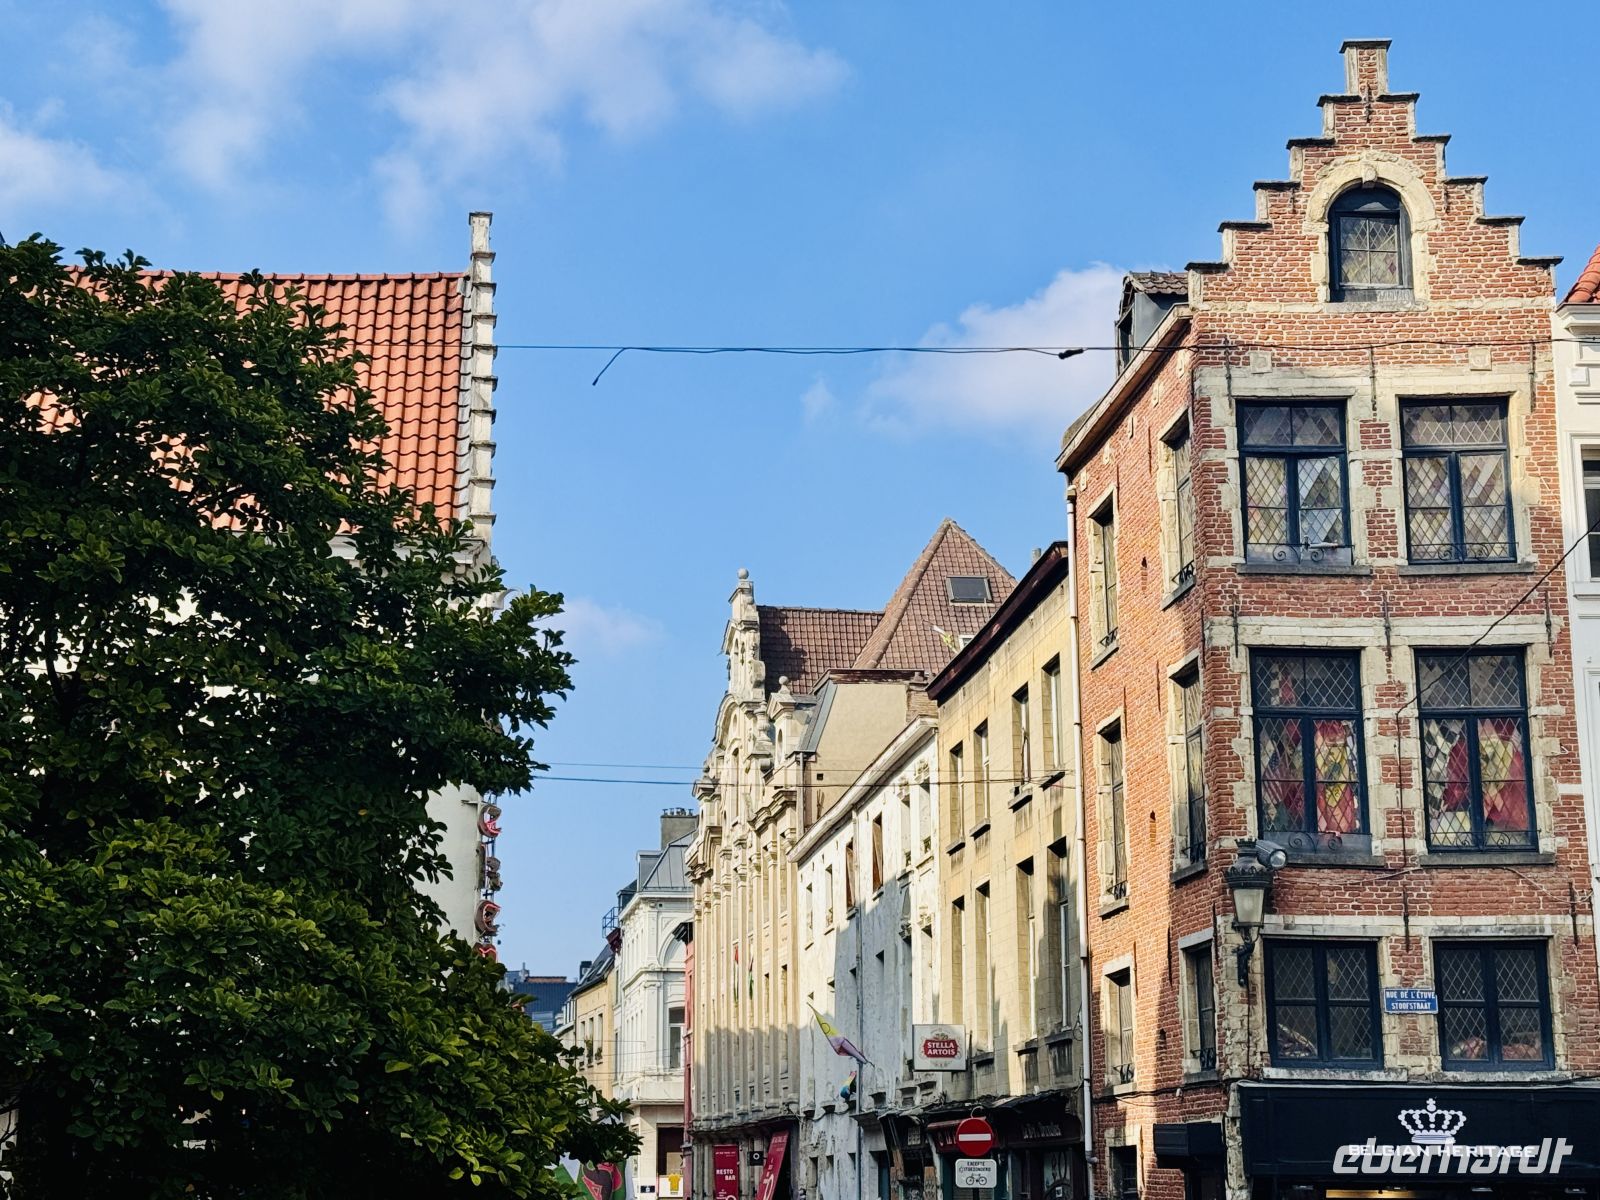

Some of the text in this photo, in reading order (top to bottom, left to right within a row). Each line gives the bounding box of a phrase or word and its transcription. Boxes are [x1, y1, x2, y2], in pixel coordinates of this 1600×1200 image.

[1385, 990, 1436, 999] RUE DE L'ÉTUVE
[1392, 1002, 1431, 1010] STOOFSTRAAT
[927, 1041, 955, 1049] STELLA
[1348, 1144, 1536, 1158] BELGIAN HERITAGE
